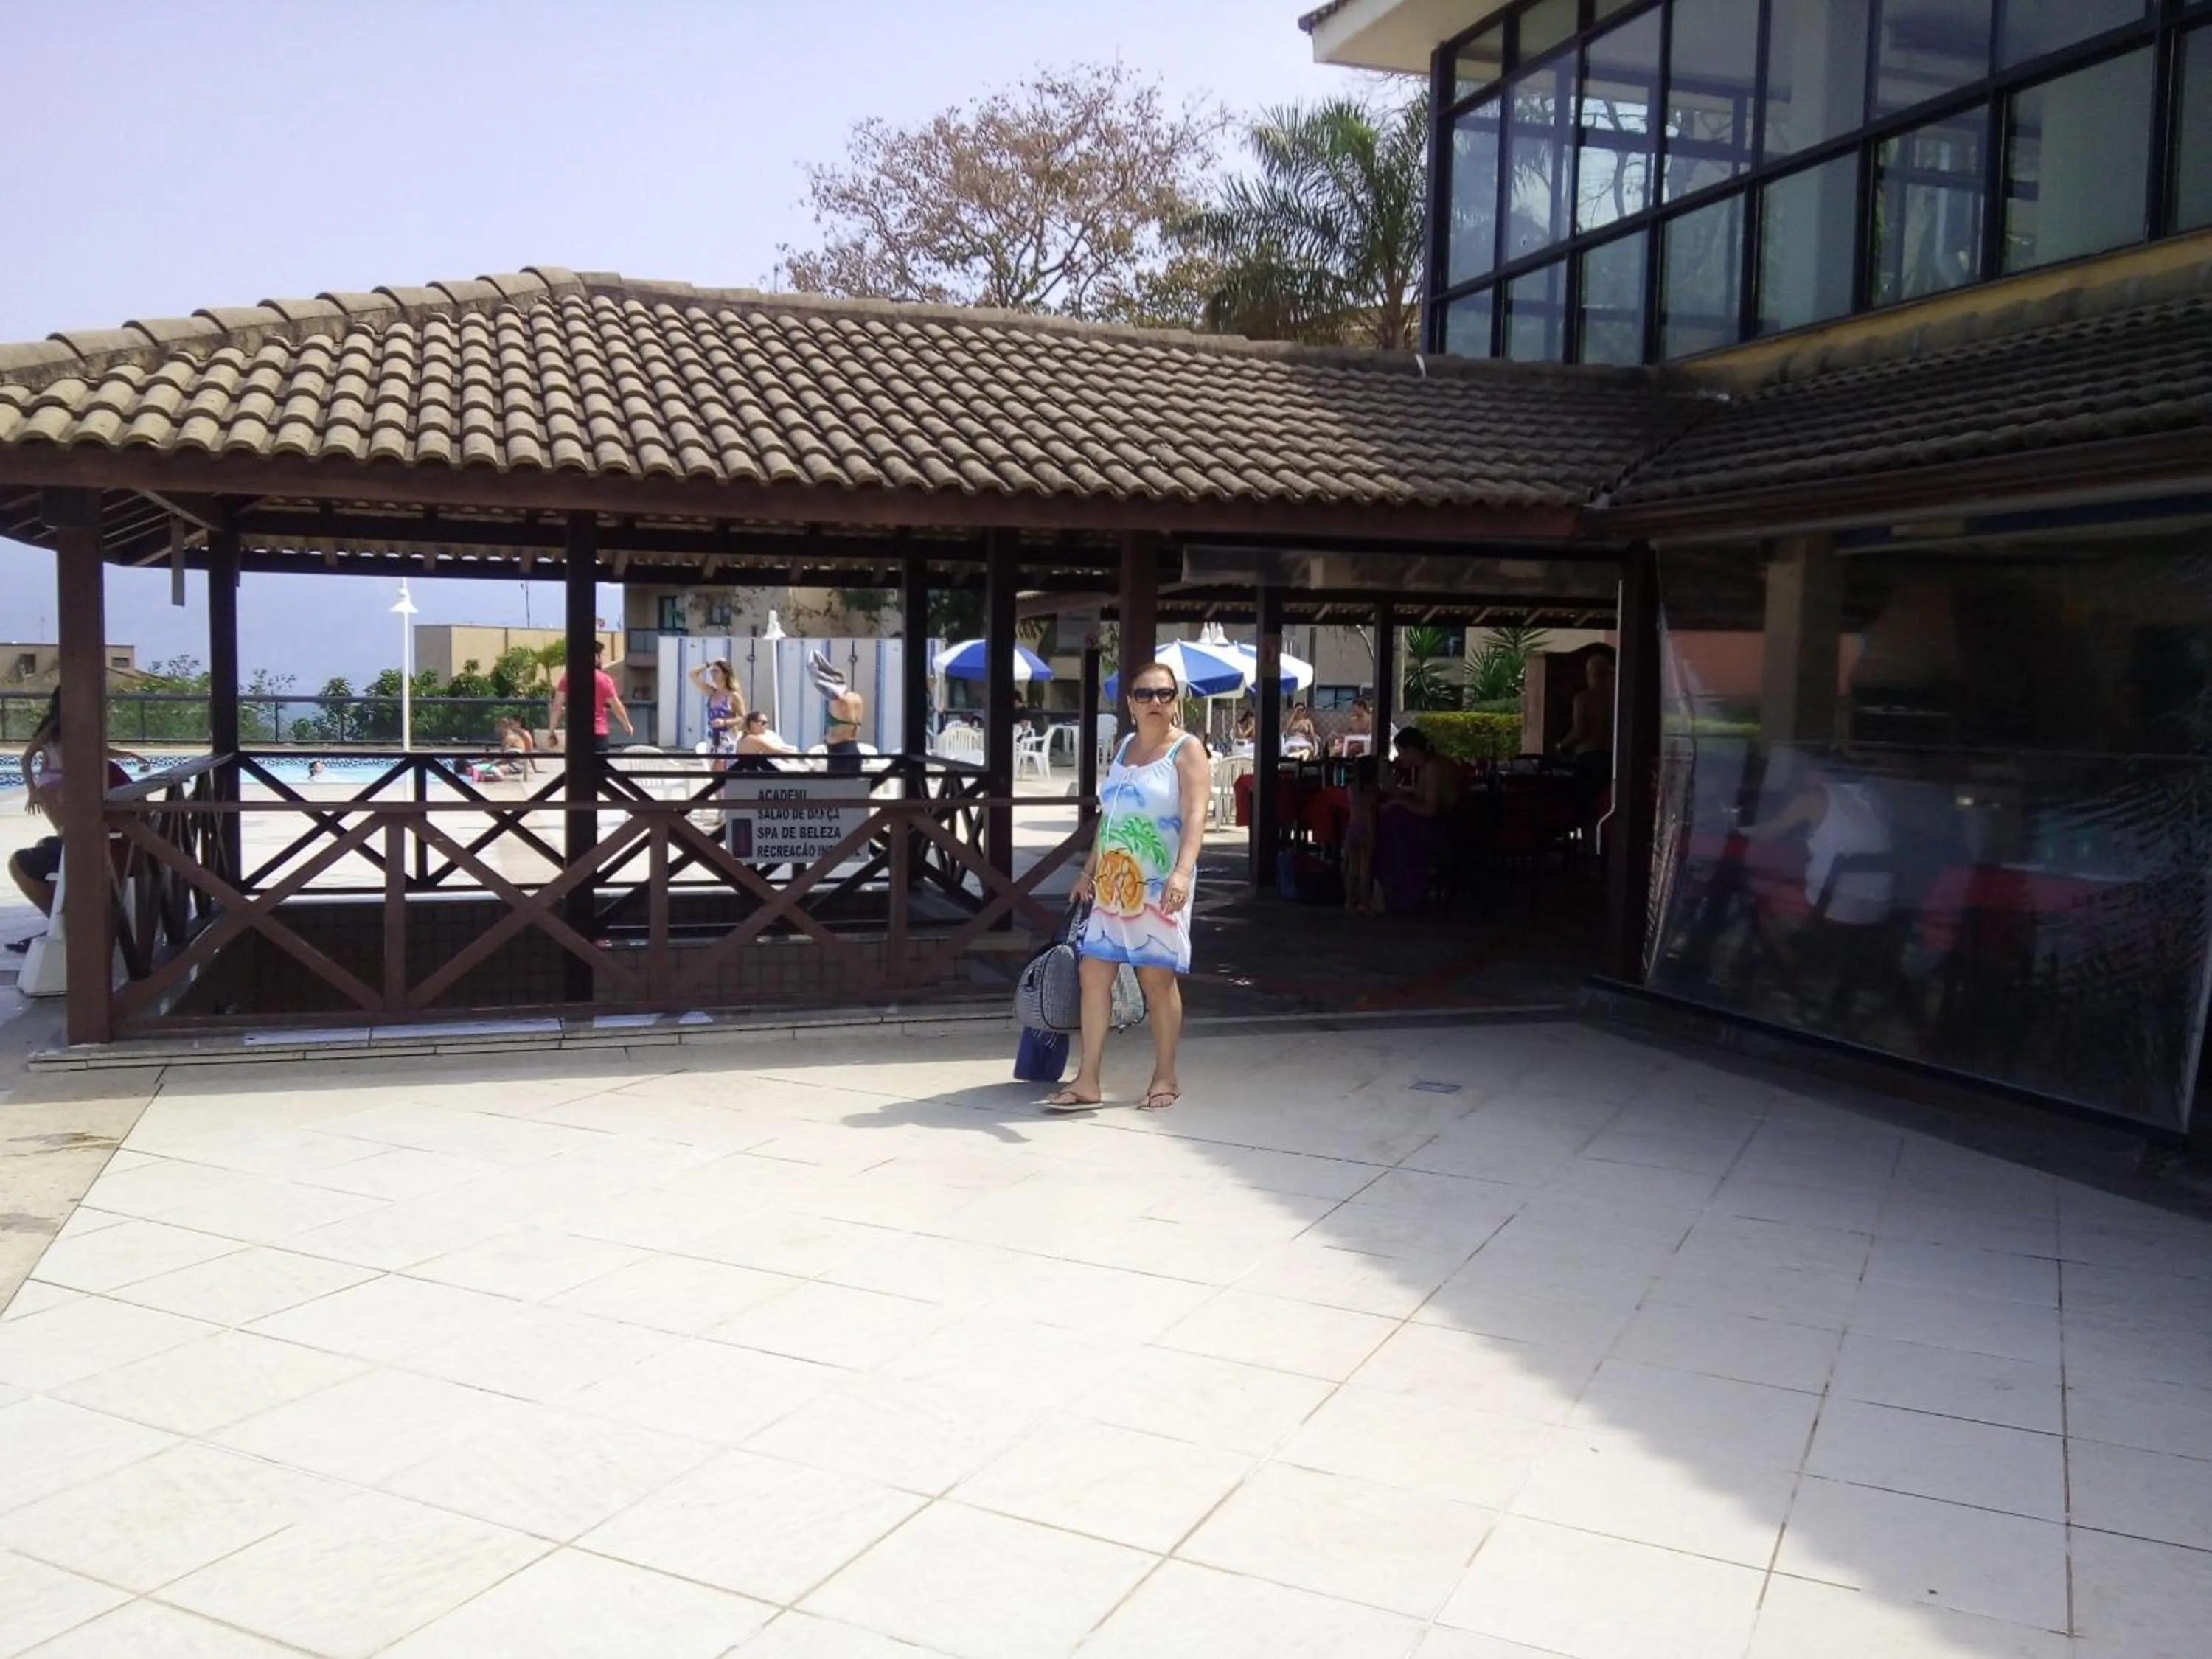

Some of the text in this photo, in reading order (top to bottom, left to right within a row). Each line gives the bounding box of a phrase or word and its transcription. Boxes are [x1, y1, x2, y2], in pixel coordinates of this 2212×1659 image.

[757, 827, 841, 839] SPA DE BELEZA
